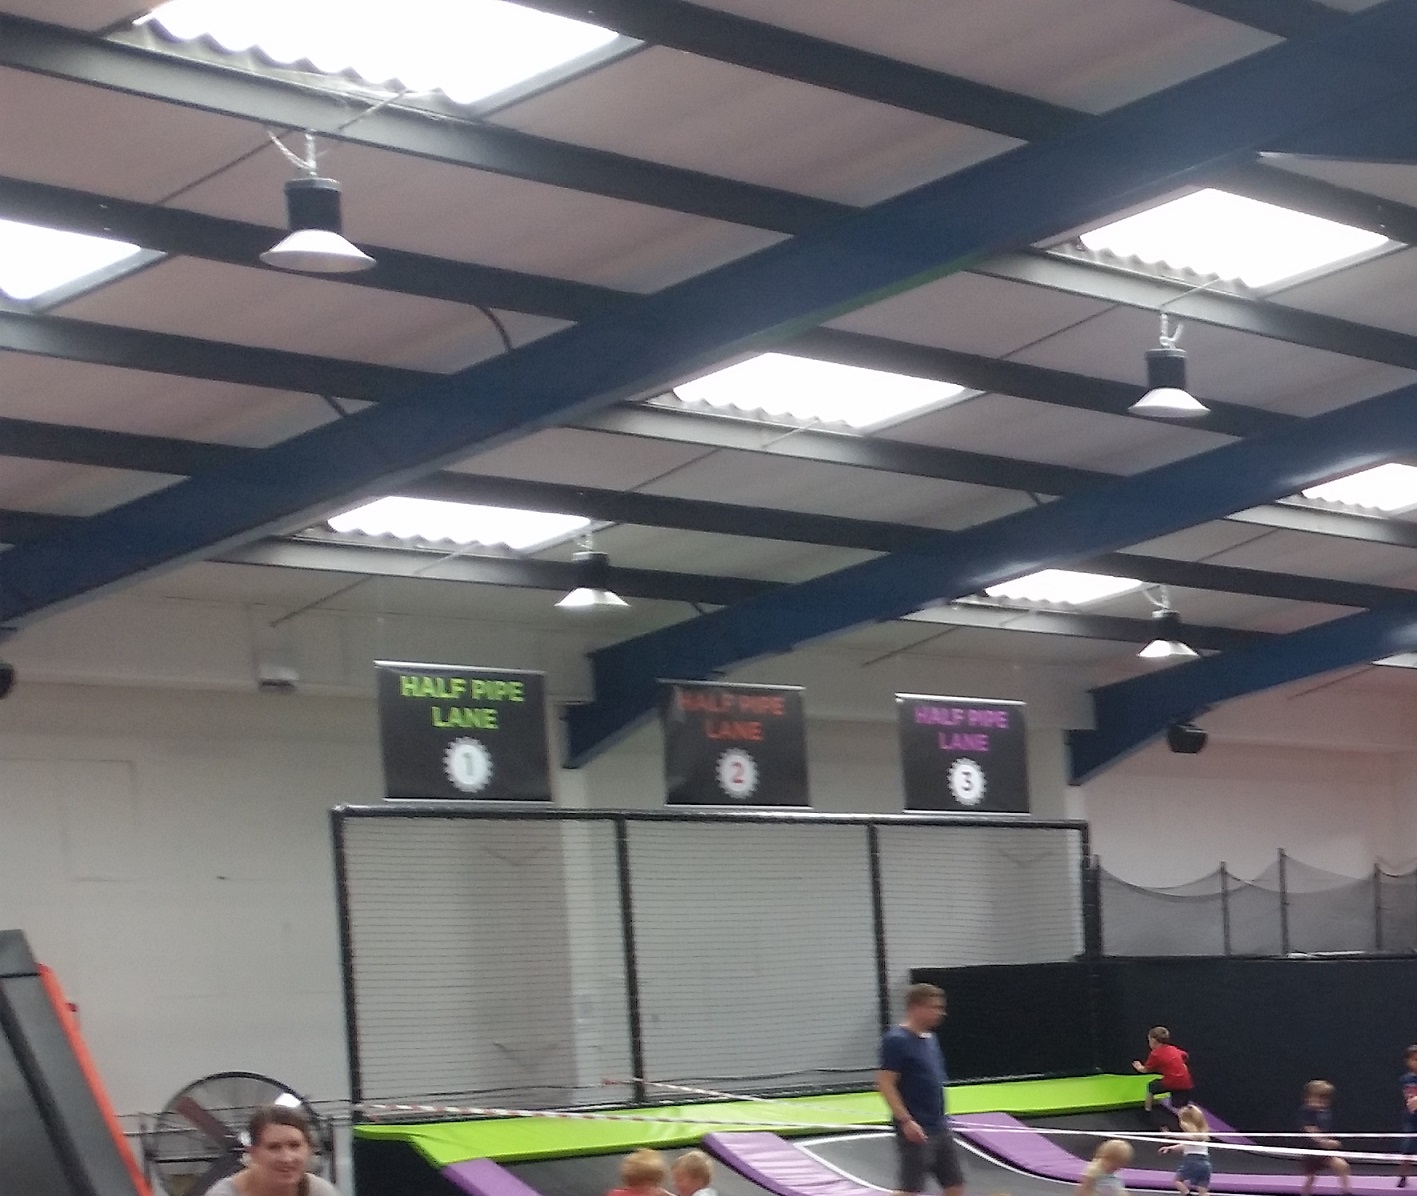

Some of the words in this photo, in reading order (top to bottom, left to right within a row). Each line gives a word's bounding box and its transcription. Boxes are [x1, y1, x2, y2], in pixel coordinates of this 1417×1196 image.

[401, 675, 466, 699] HALF
[470, 679, 525, 702] PIPE
[431, 706, 499, 729] LANE
[915, 706, 964, 726] HALF
[967, 708, 1008, 729] PIPE
[706, 720, 763, 741] LANE
[938, 731, 988, 752] LANE
[462, 752, 474, 776] 1
[731, 762, 744, 784] 2
[961, 771, 973, 791] 3
